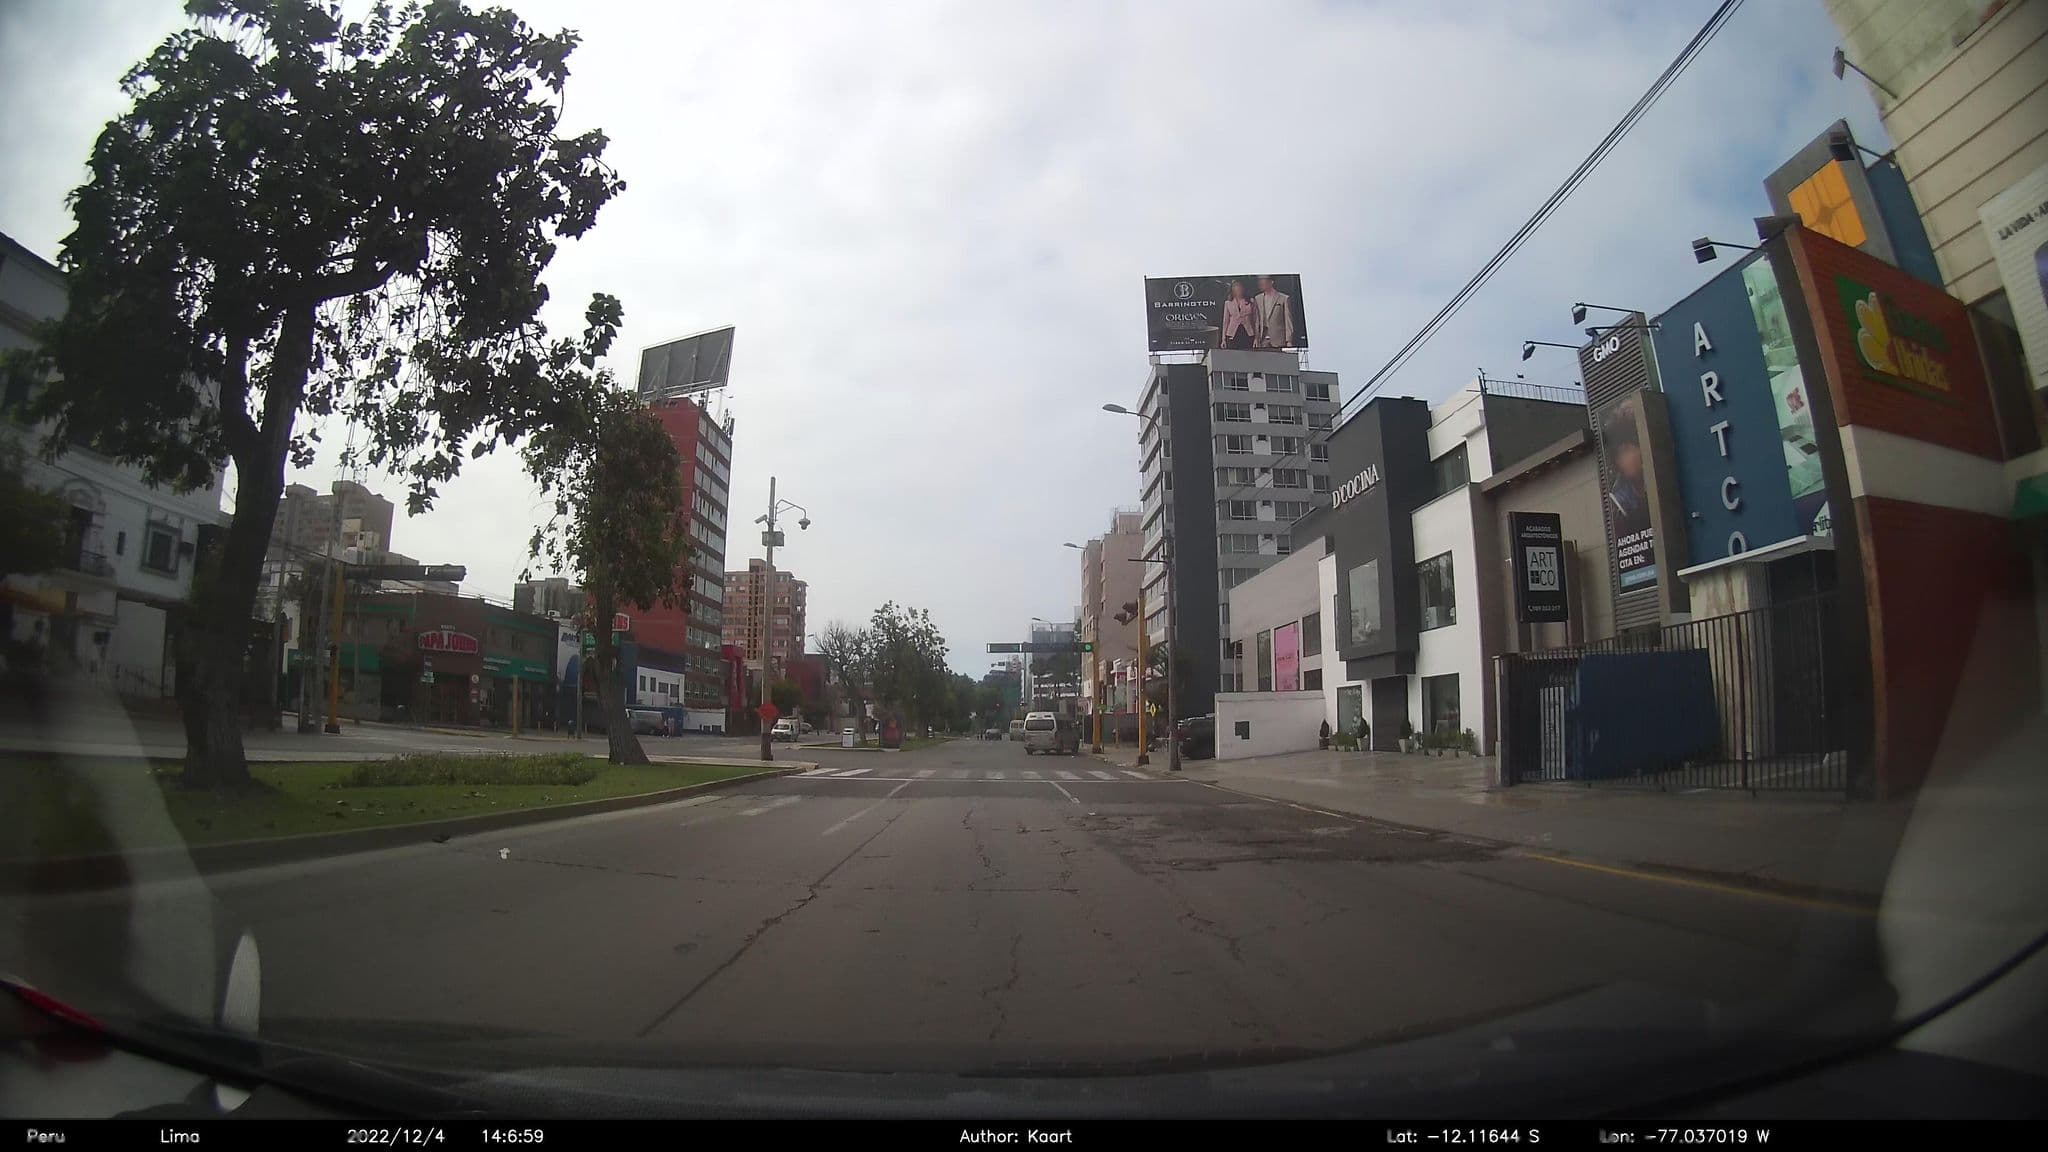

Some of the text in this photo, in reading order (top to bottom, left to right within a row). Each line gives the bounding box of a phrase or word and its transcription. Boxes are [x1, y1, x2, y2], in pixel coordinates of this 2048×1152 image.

[1153, 300, 1216, 308] BARRINGTON
[1592, 335, 1621, 362] GMO
[1617, 532, 1640, 548] AHORA
[1618, 541, 1649, 559] AGENDAR
[1530, 551, 1555, 568] ART
[1540, 569, 1556, 586] CO
